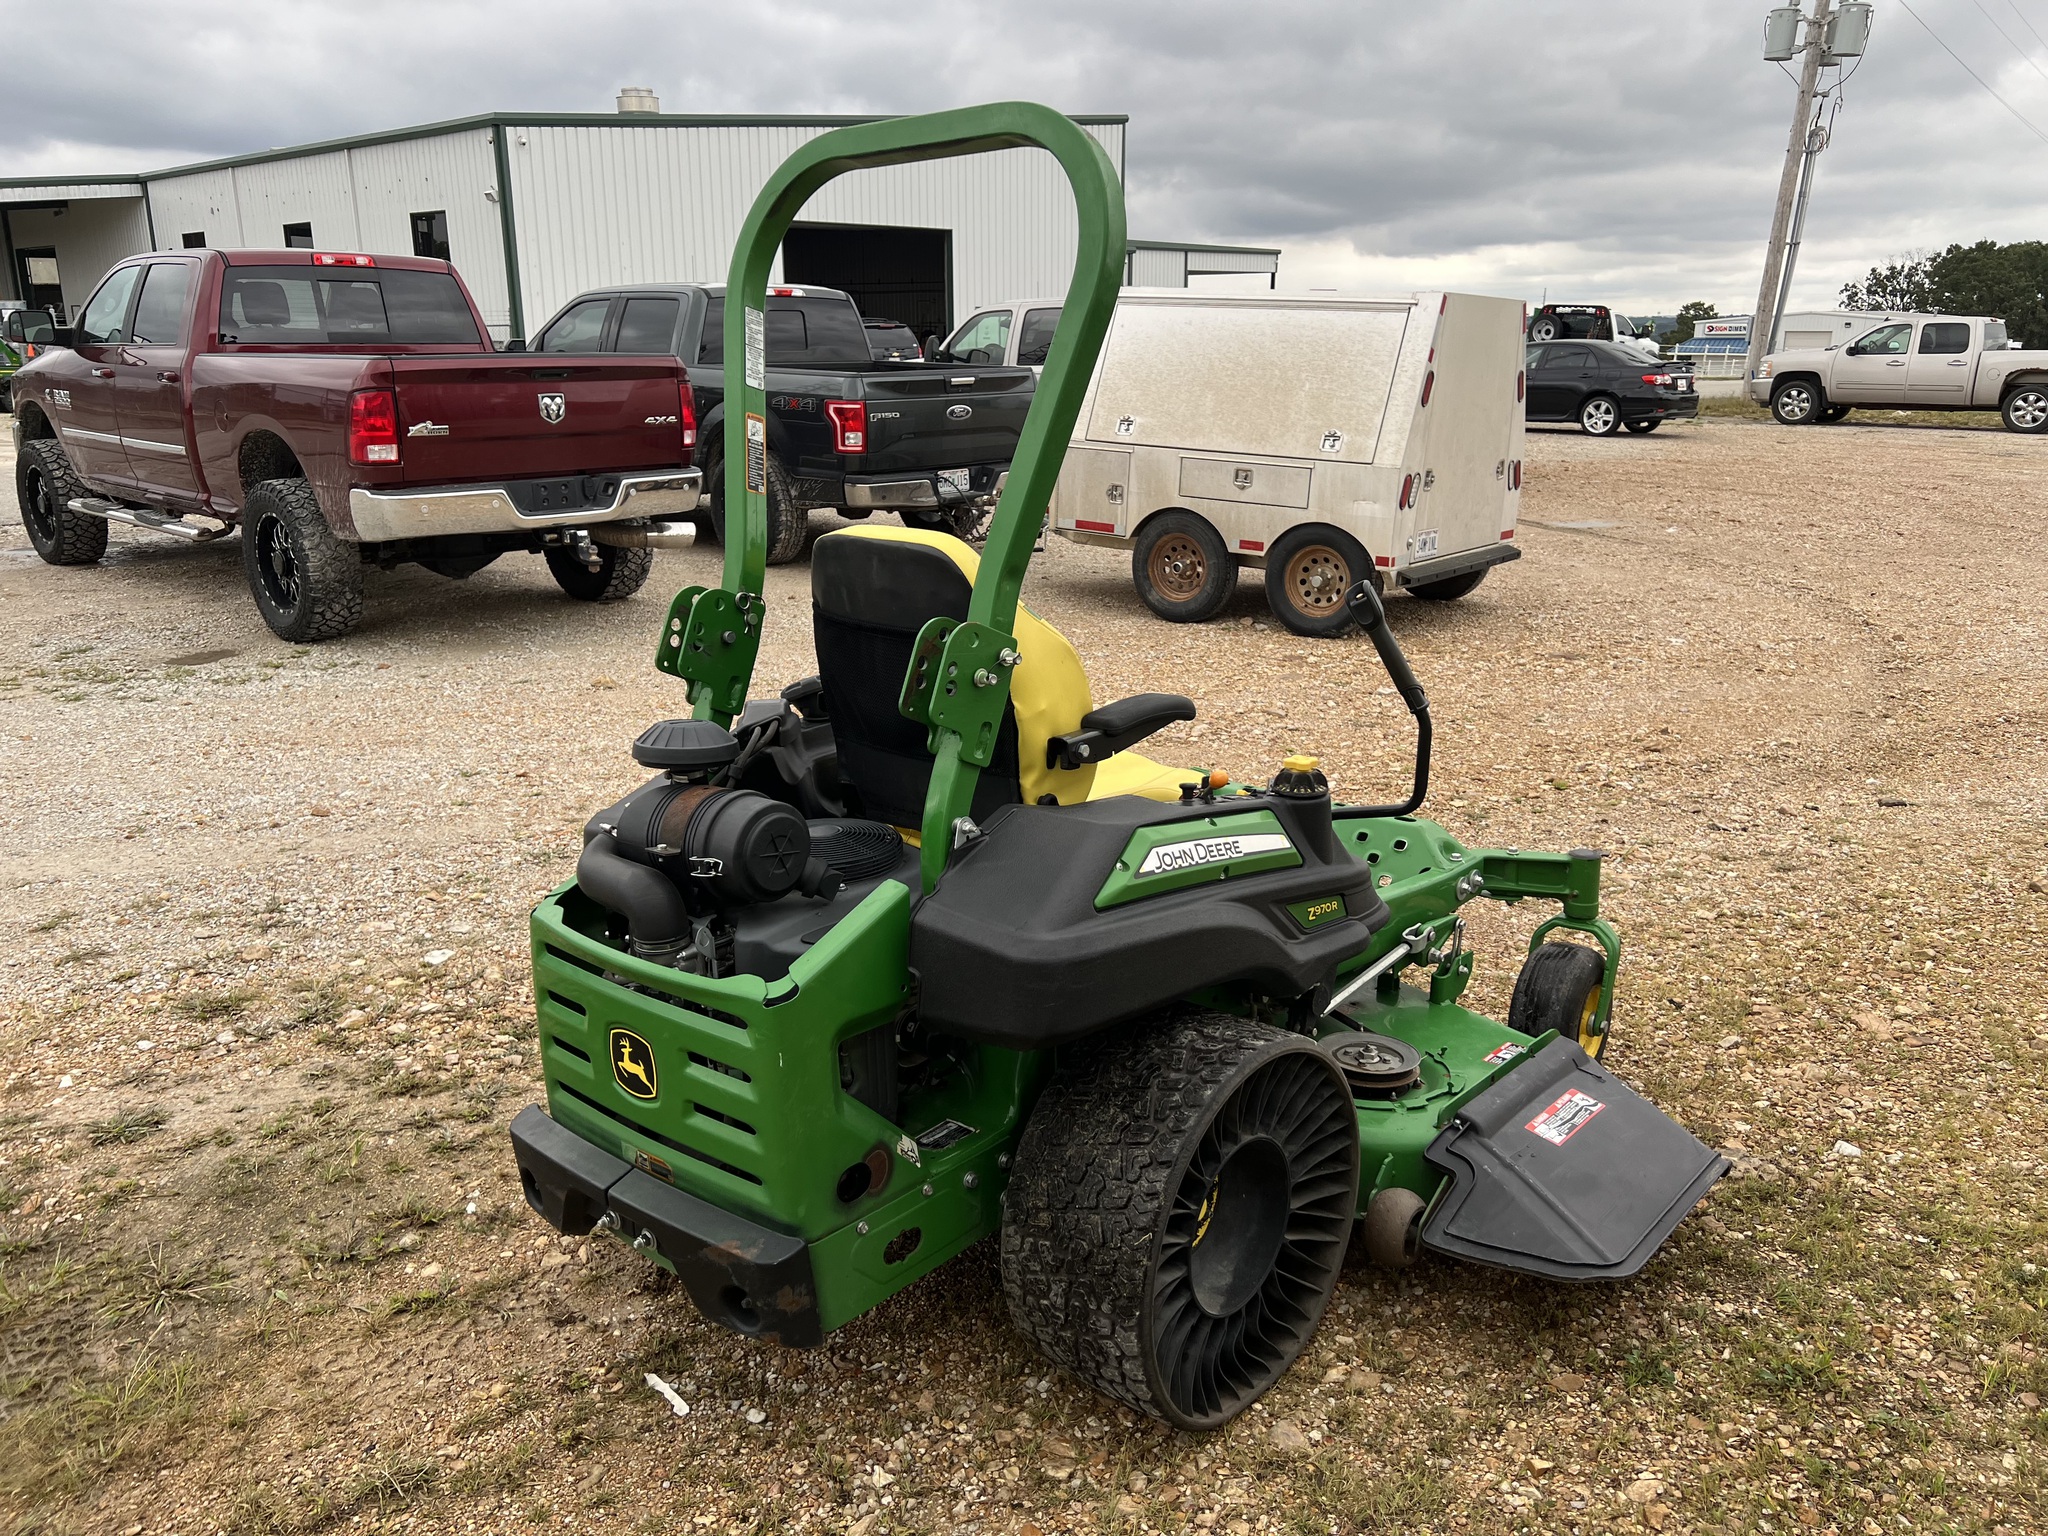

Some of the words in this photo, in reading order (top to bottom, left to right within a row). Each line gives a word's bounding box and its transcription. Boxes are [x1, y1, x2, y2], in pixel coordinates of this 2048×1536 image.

[1155, 848, 1196, 870] JOHN
[1194, 840, 1243, 861] DEERE
[1307, 900, 1338, 921] Z970R
